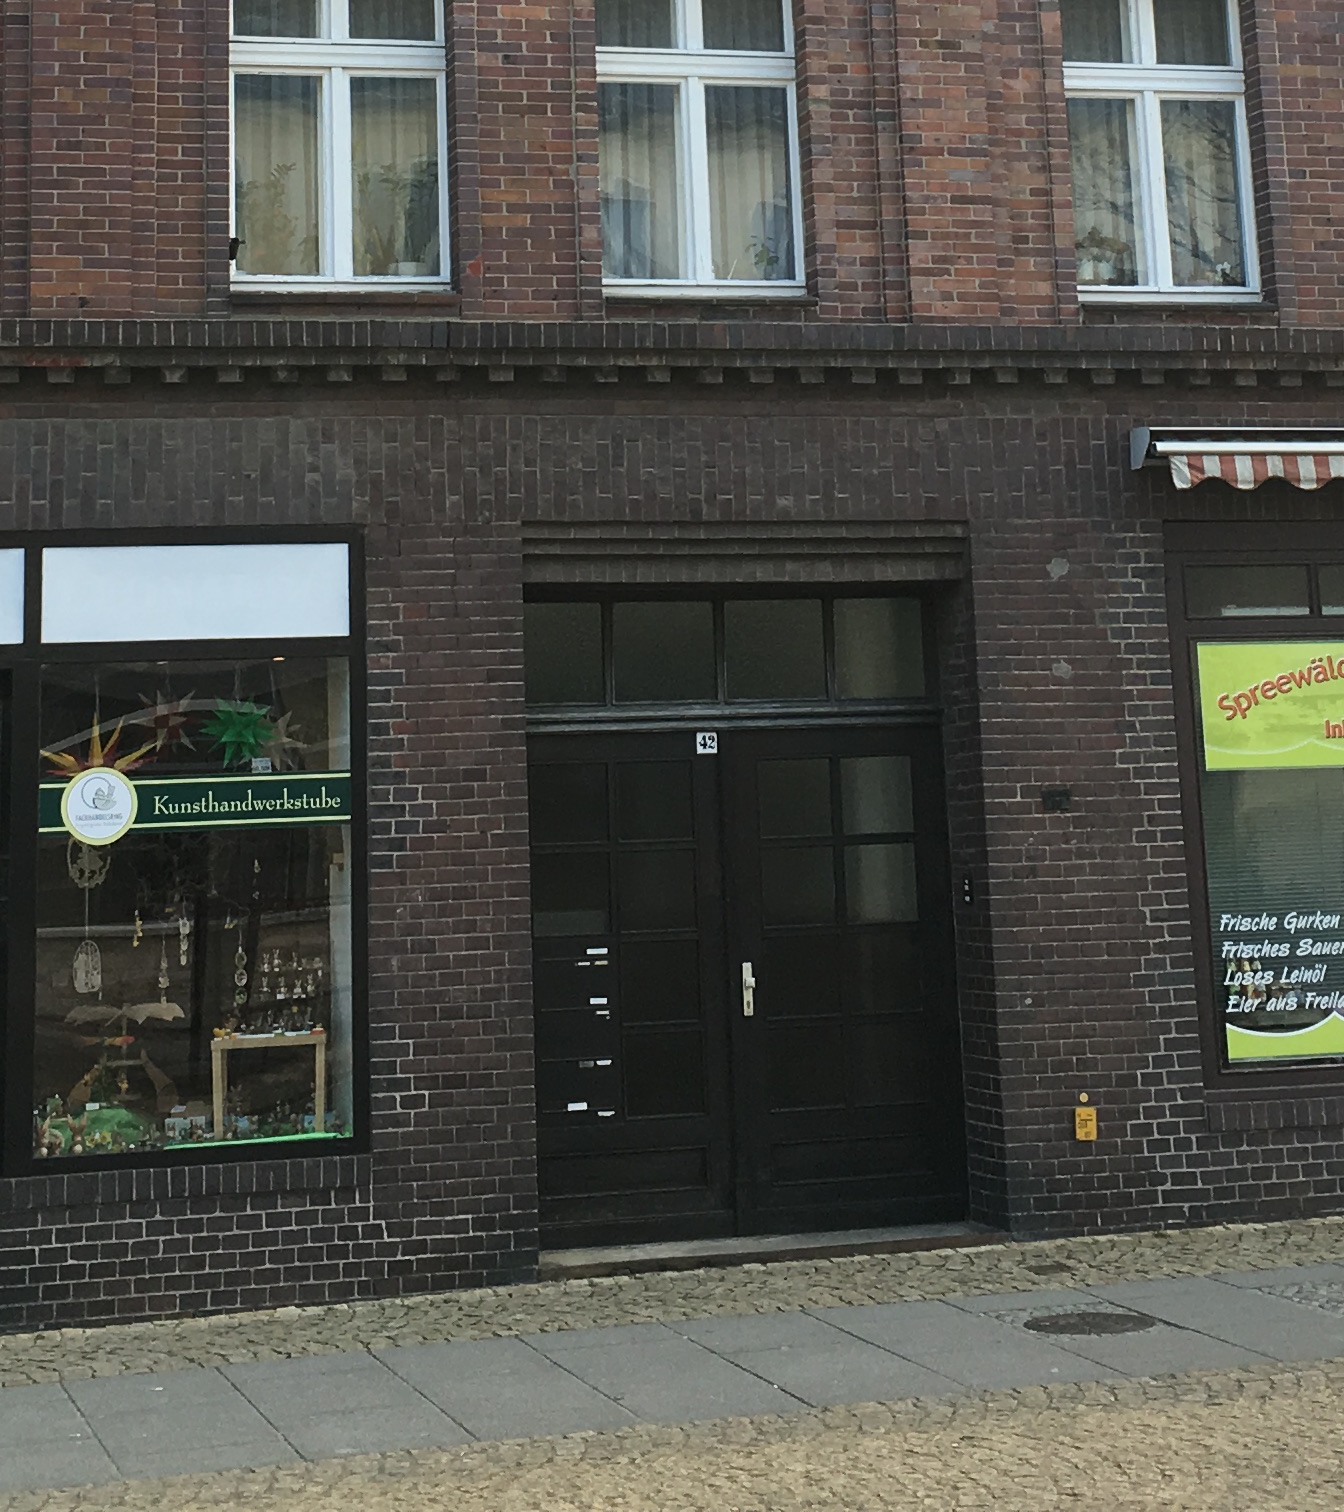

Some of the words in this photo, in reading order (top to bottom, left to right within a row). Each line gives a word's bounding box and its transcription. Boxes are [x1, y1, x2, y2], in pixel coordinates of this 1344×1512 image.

[698, 734, 716, 750] 42
[153, 786, 342, 815] Kunsthandwerkstube
[1219, 912, 1277, 932] Frische
[1283, 910, 1341, 934] Gurken
[1221, 939, 1290, 959] Frisches
[1223, 968, 1274, 986] Loses
[1279, 964, 1327, 984] Leinöl
[1225, 994, 1262, 1013] Eier
[1266, 996, 1298, 1012] aus
